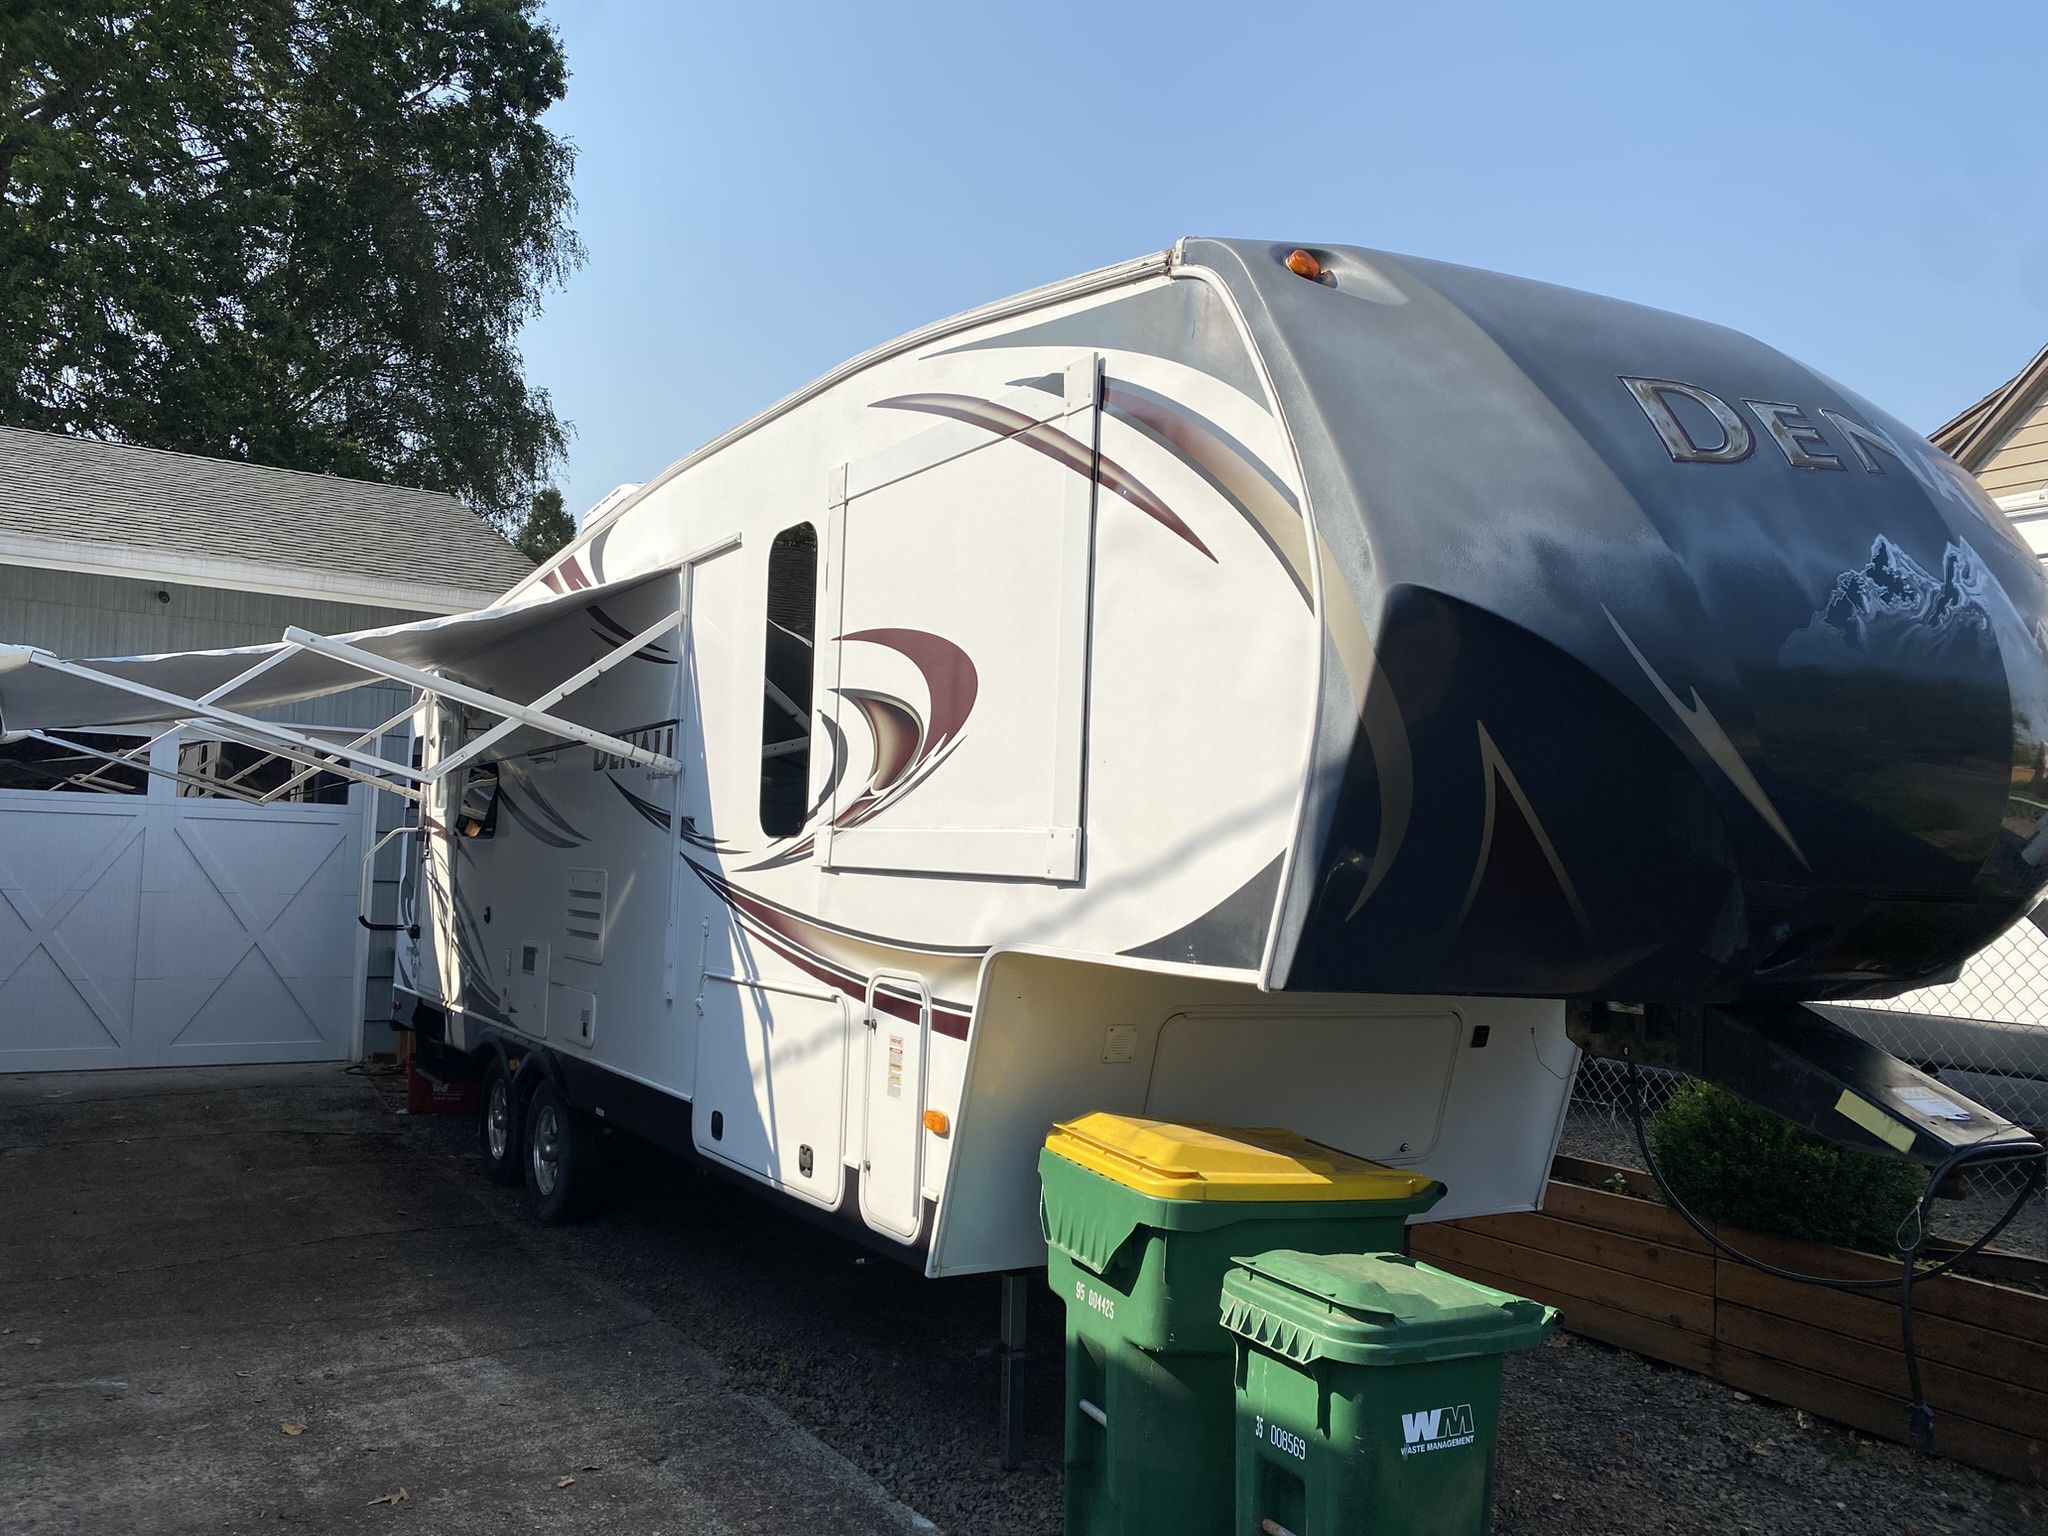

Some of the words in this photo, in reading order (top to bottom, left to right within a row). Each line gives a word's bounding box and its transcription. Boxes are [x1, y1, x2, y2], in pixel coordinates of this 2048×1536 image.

[1076, 1281, 1085, 1301] 95
[1089, 1289, 1114, 1320] 004425
[1270, 1424, 1306, 1460] 008569
[1401, 1404, 1475, 1444] WM
[1400, 1444, 1426, 1456] WASTE
[1426, 1435, 1475, 1452] MANAGEMENT
